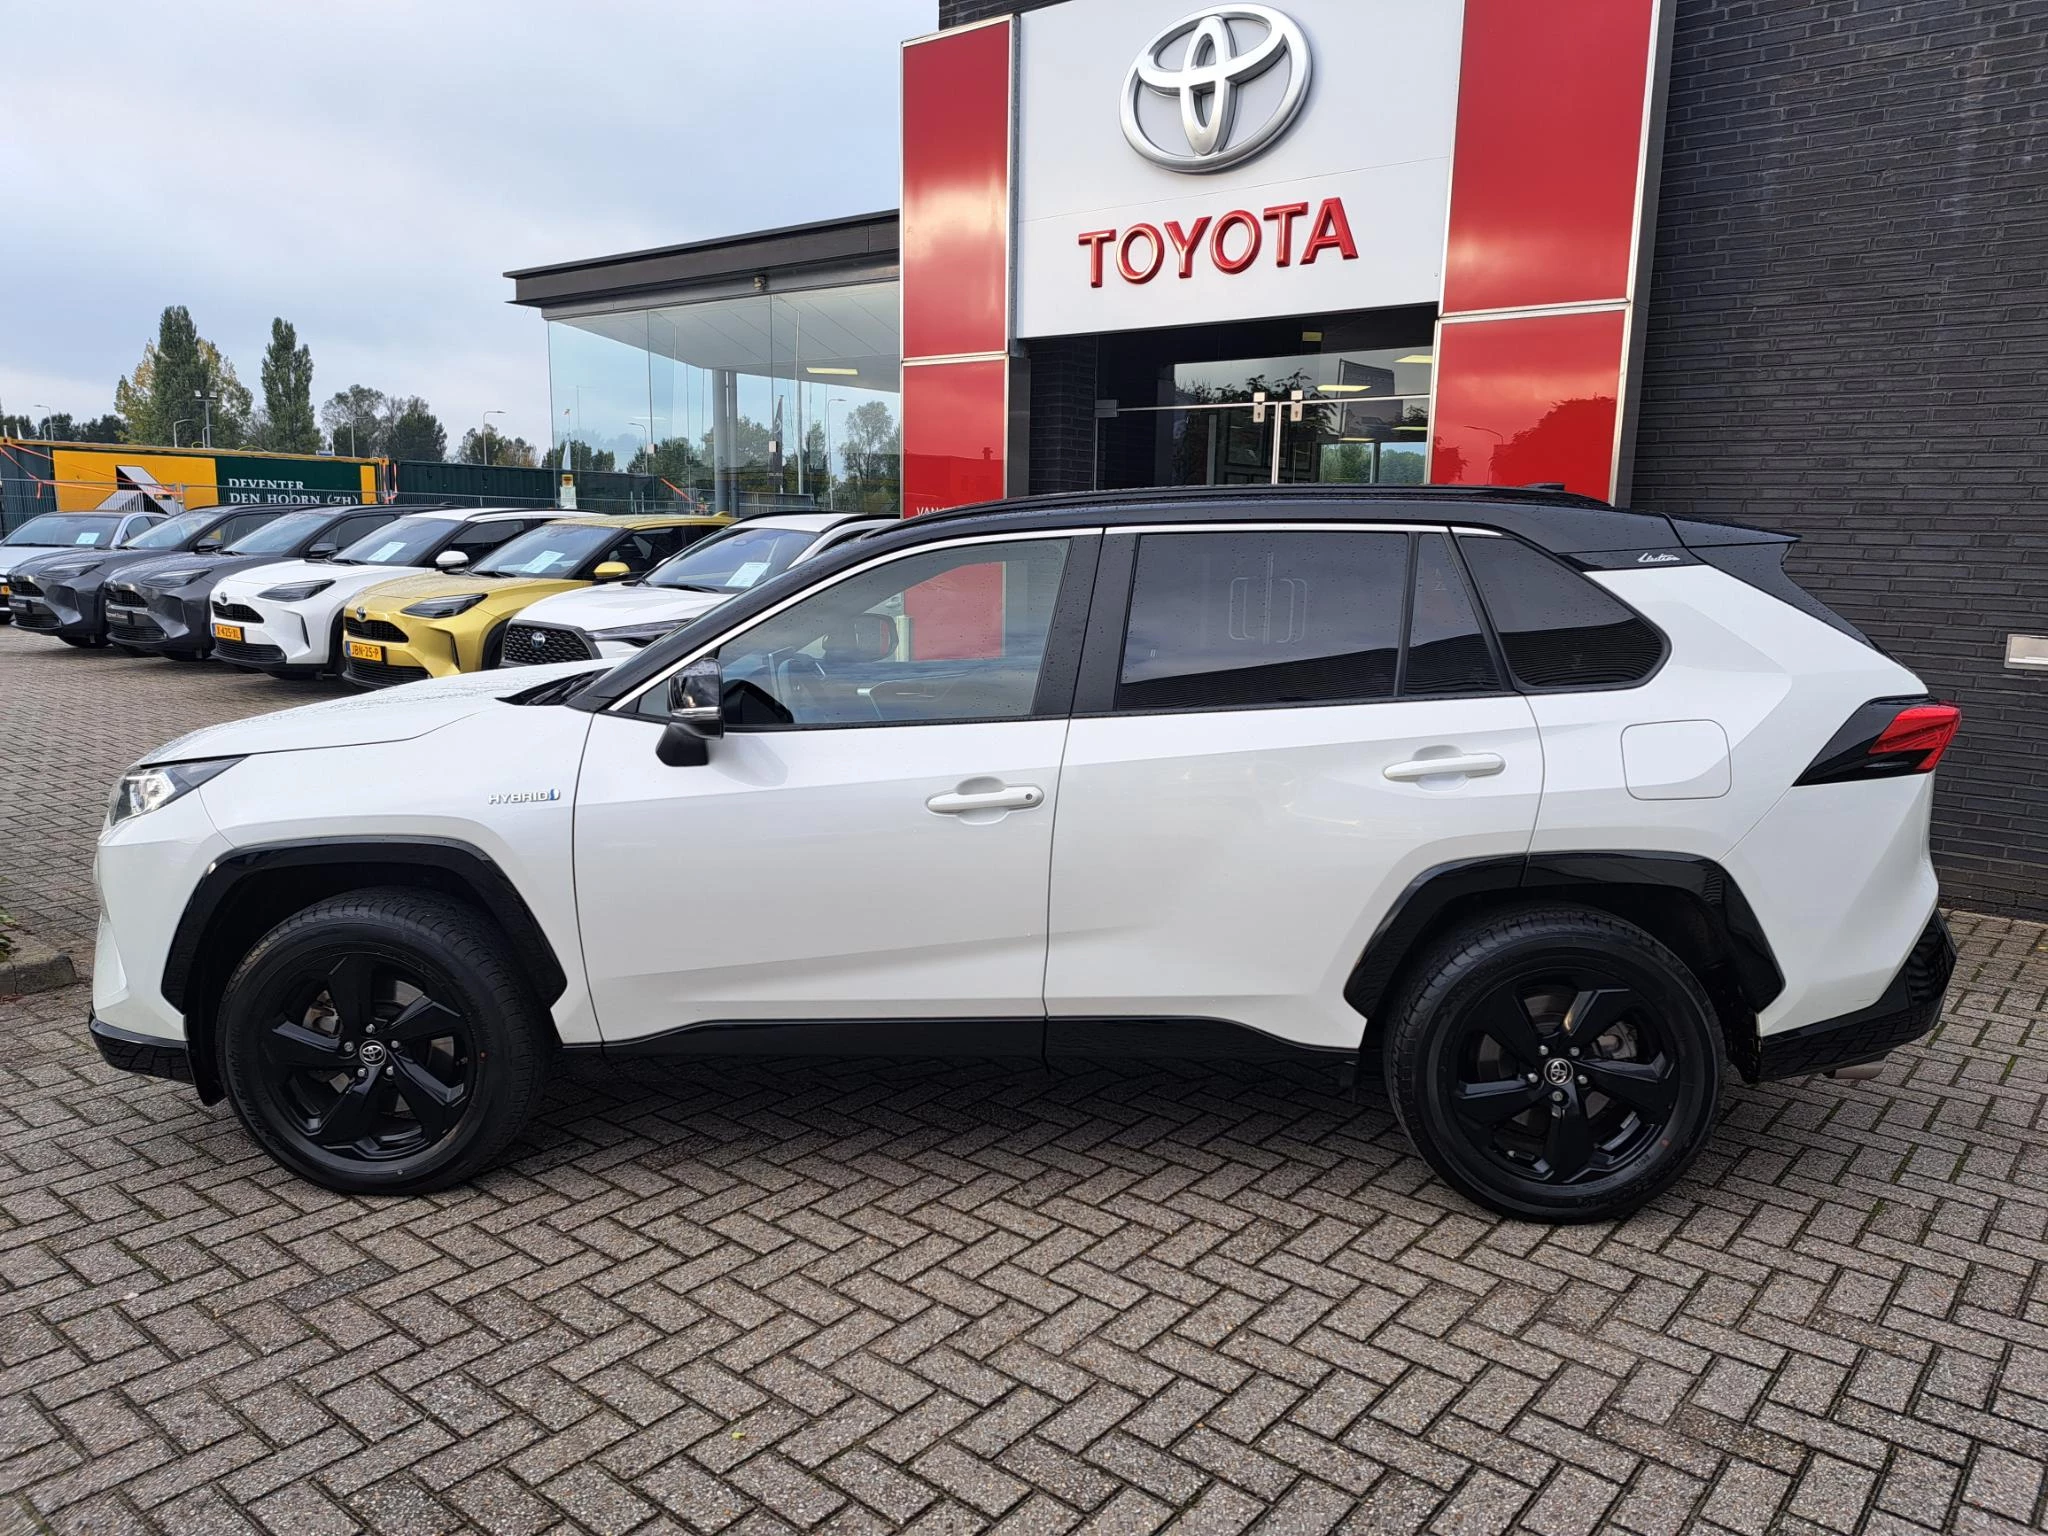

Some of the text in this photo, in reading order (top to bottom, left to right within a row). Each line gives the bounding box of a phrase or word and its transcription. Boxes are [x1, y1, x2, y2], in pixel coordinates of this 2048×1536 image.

[1078, 196, 1359, 289] TOYOTA
[228, 478, 304, 490] DEVENTER
[230, 493, 359, 505] DEN HOORN (ZH)
[488, 791, 548, 804] HYBRID
